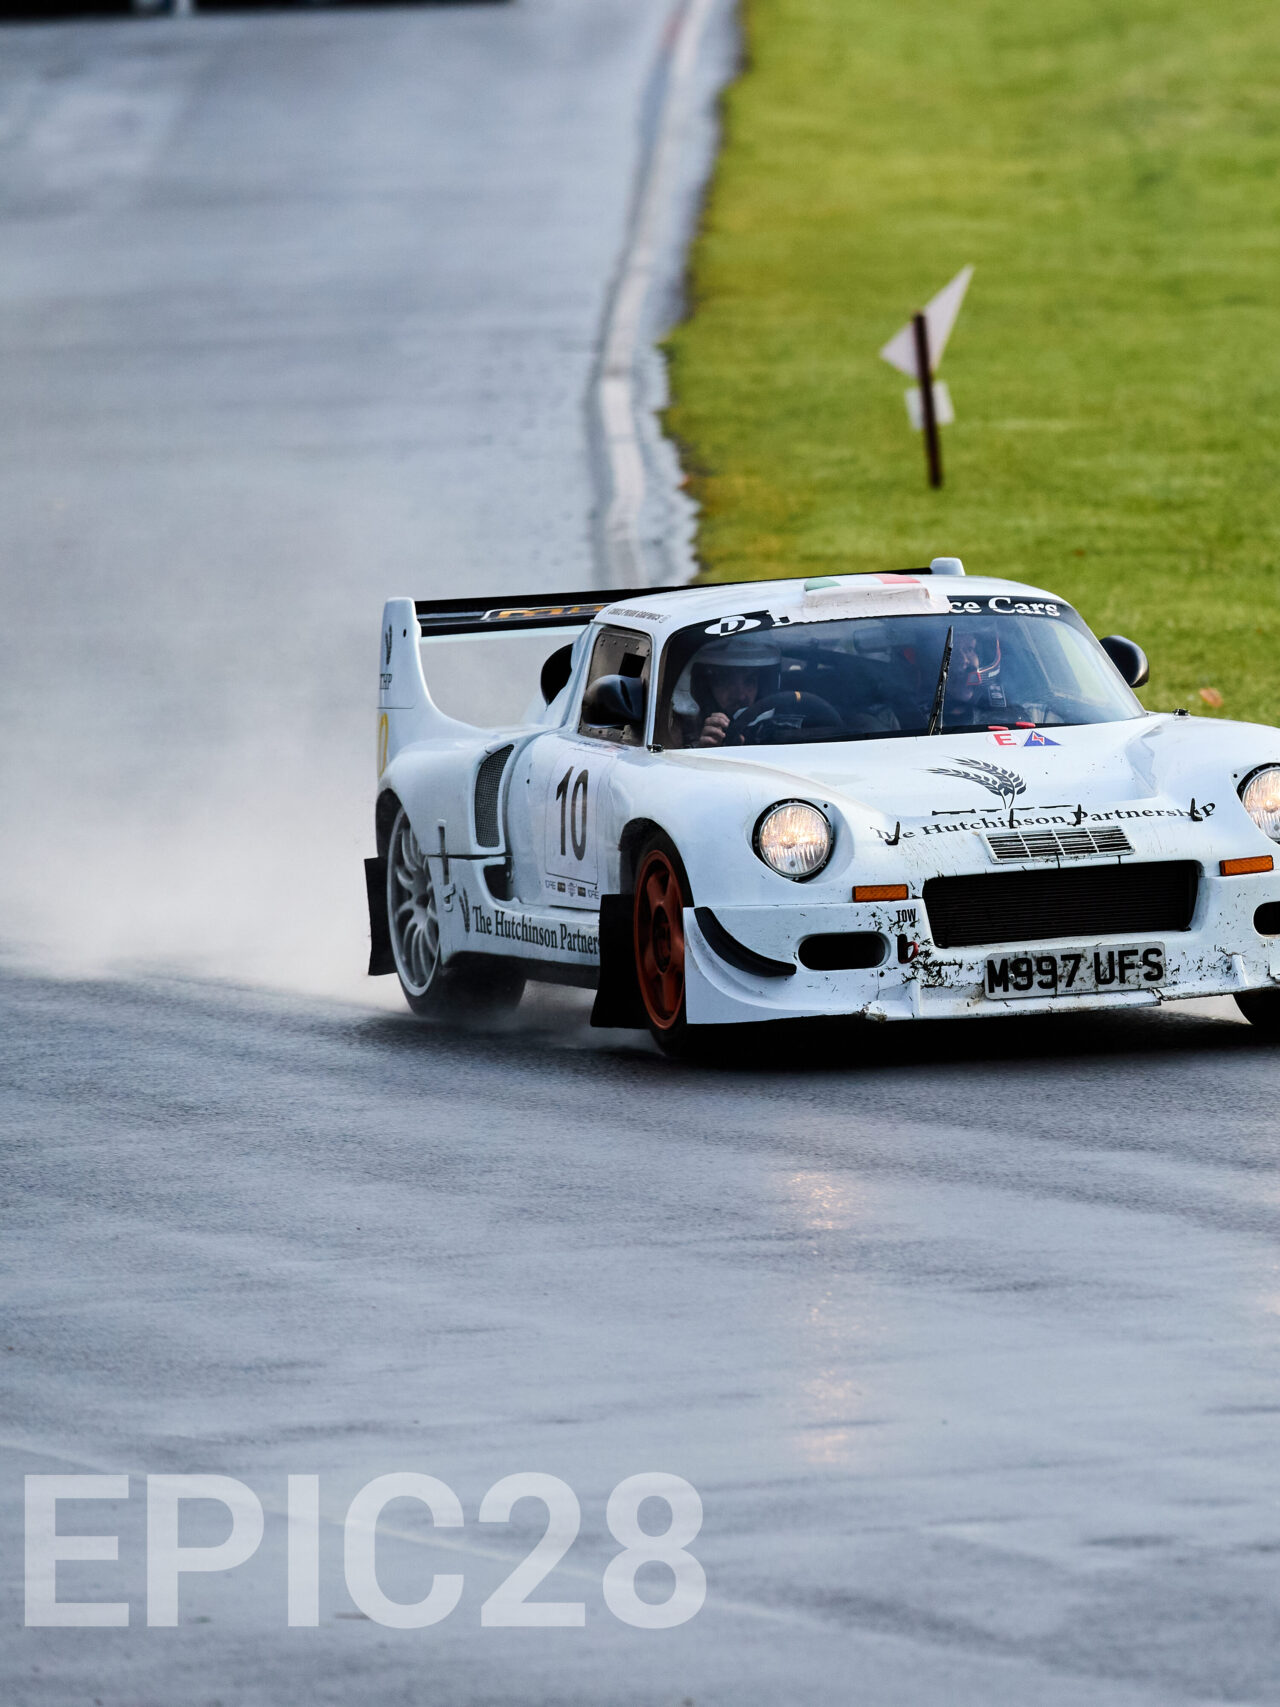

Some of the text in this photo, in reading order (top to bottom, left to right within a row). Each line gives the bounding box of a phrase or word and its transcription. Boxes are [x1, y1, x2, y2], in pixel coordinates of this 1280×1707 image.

[988, 596, 1061, 617] Cars
[993, 733, 1017, 746] E
[555, 765, 589, 861] 10
[920, 813, 1067, 836] Hutchinson
[896, 908, 916, 922] TOW
[472, 905, 492, 935] The
[494, 909, 558, 949] Hutchinson
[987, 947, 1164, 994] M997 UFS
